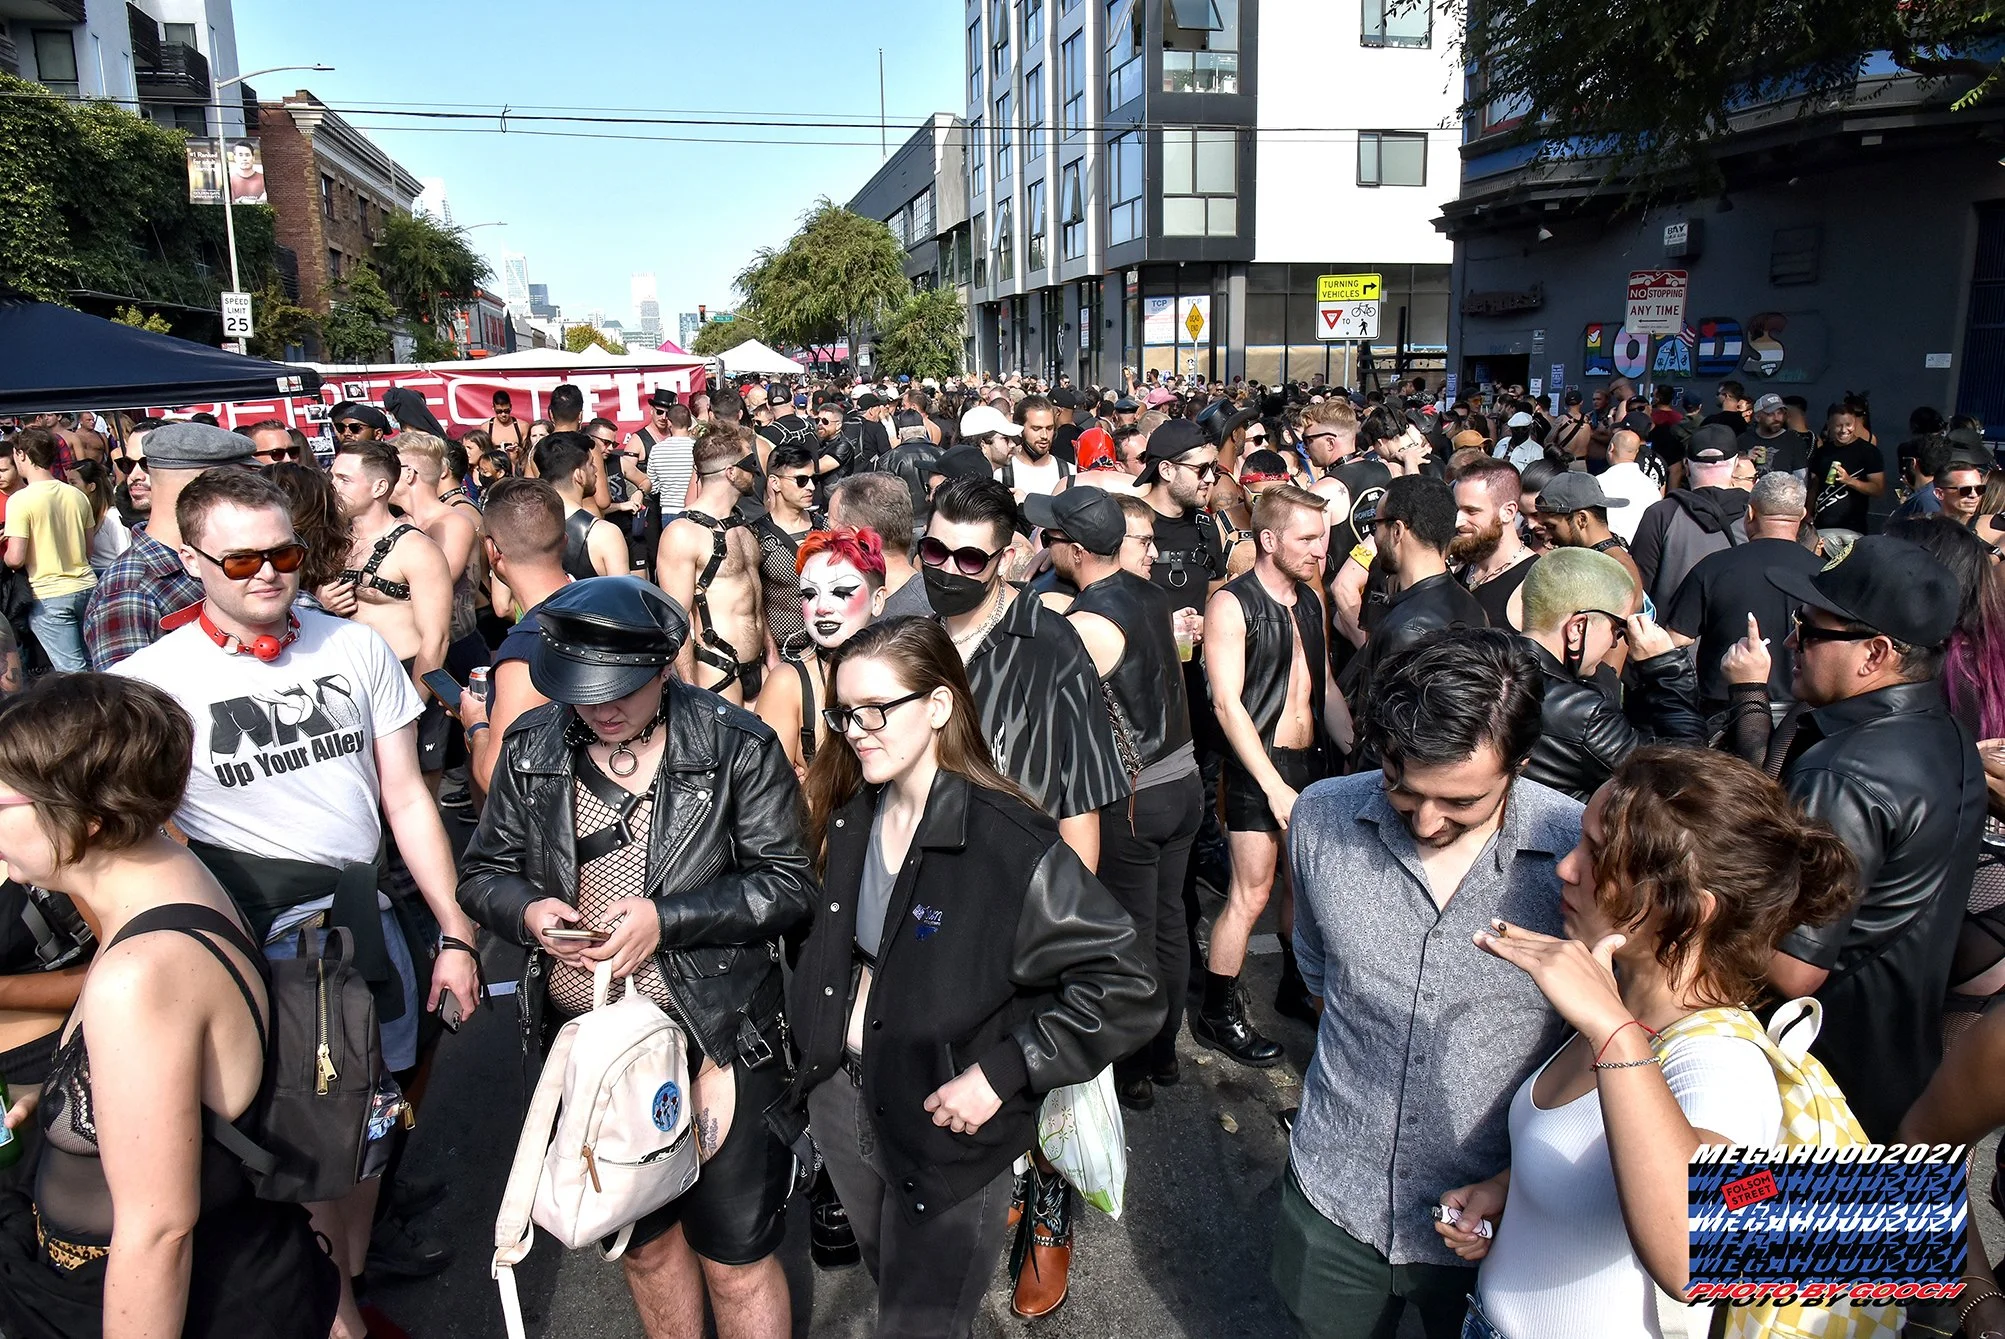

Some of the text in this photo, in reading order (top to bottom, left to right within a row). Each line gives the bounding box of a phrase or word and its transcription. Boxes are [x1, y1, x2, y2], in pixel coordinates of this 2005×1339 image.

[1667, 224, 1686, 235] BAY
[1323, 280, 1359, 288] TURNING
[1321, 290, 1360, 299] VEHICLES
[1630, 288, 1683, 298] NO STOPPING
[224, 297, 249, 305] SPEED
[1151, 299, 1168, 307] TCP
[1630, 305, 1680, 316] ANY TIME
[226, 317, 249, 332] 25
[214, 729, 365, 788] Up Your Alley
